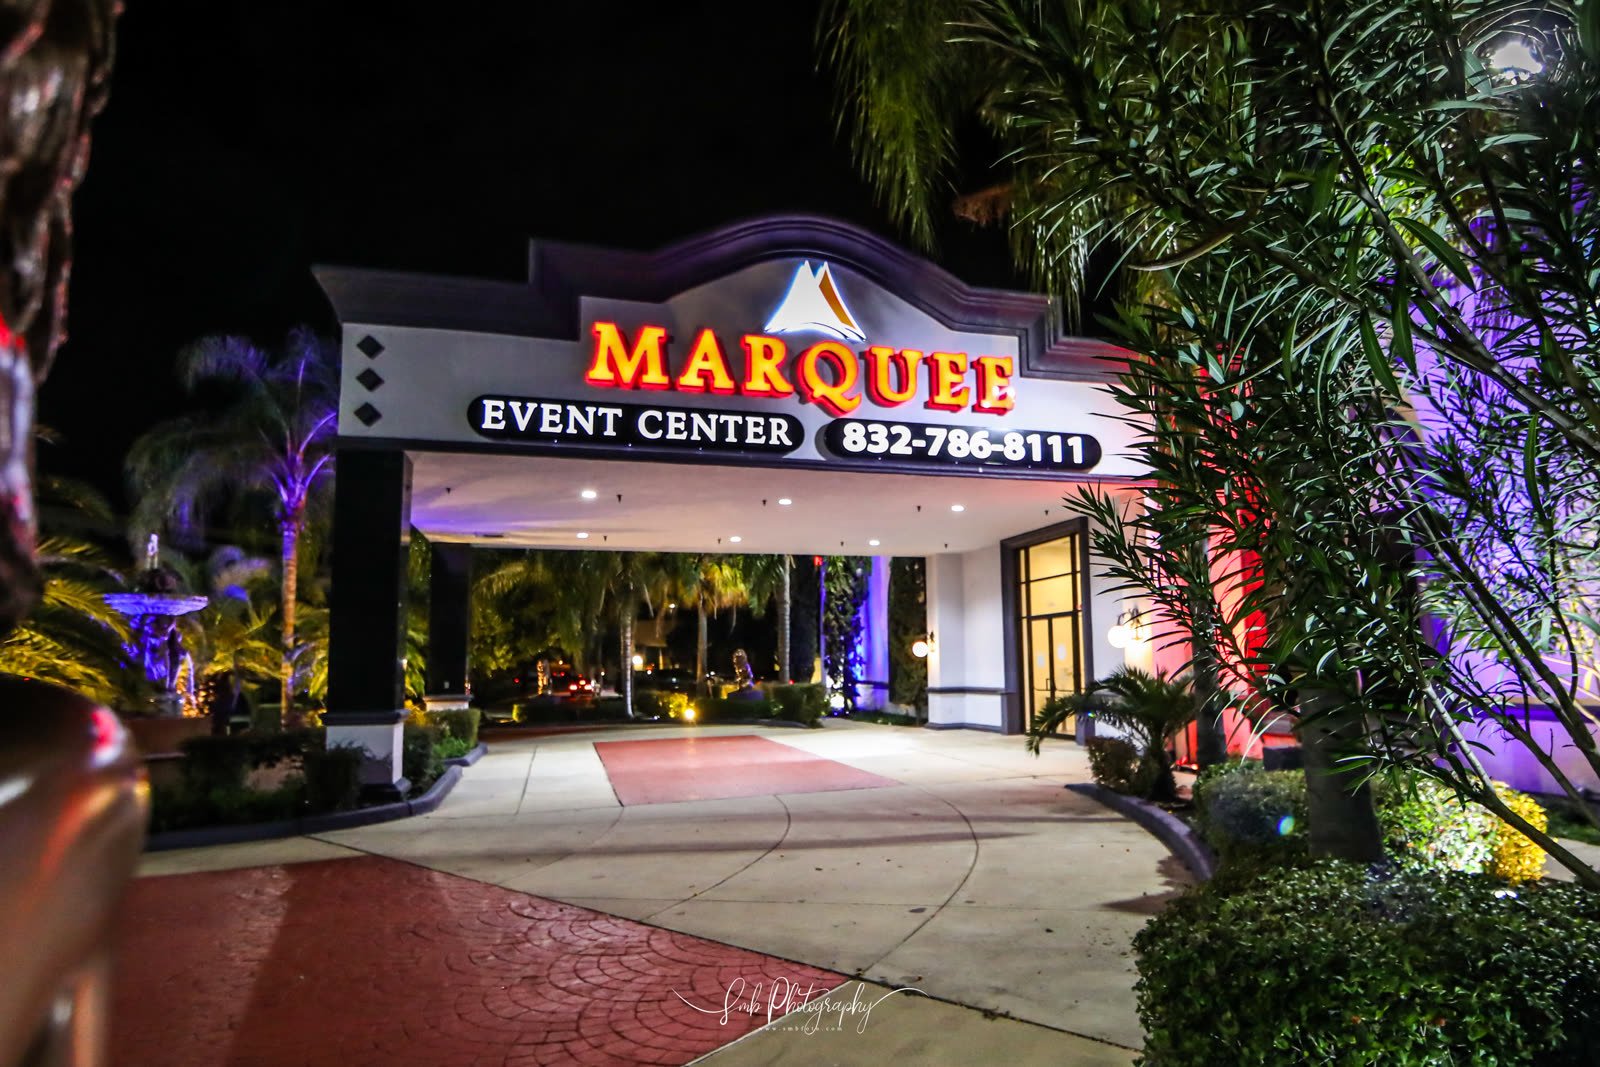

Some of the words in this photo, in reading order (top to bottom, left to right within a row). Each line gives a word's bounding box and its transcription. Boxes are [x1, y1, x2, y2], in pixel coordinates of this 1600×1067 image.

[585, 321, 1016, 416] MARQUEE
[481, 399, 623, 436] EVENT
[637, 409, 793, 446] CENTER
[842, 422, 1083, 464] 832-786-8111
